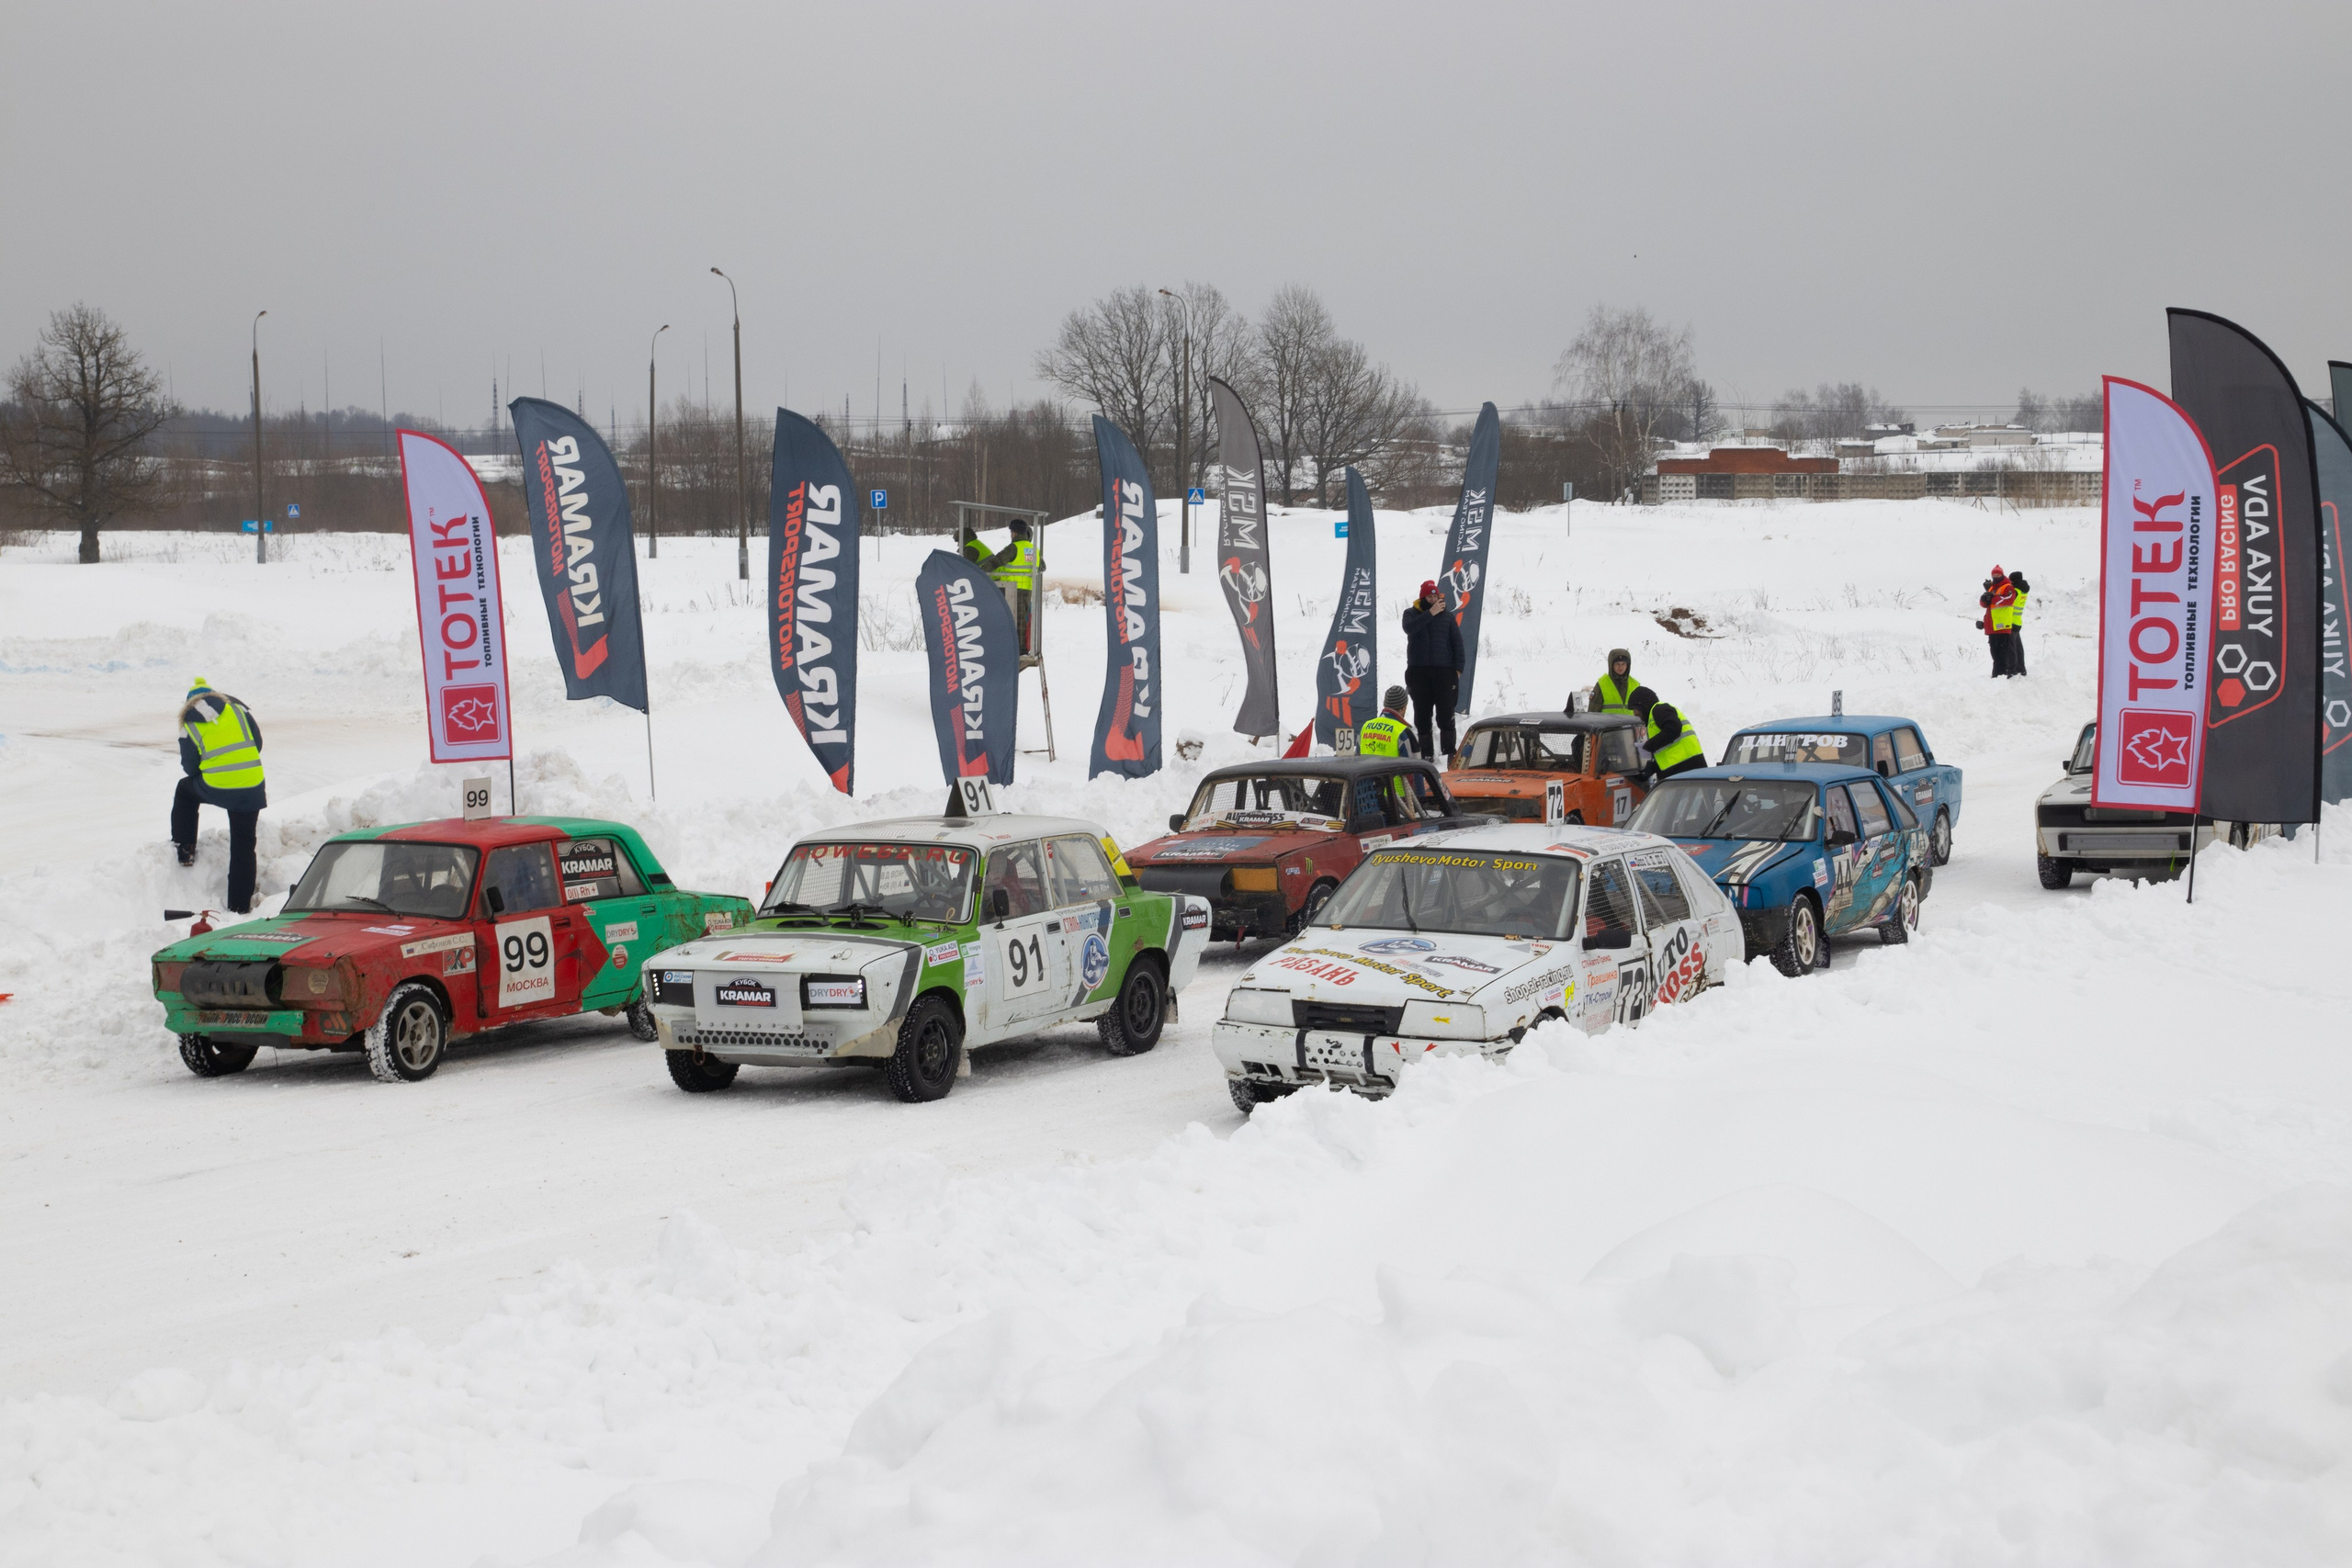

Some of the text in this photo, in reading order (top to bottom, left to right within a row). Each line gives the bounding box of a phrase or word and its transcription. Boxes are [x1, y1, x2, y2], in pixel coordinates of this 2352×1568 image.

[471, 516, 492, 667] ТОПЛИВНЫЕ ТЕХНОЛОГИИ
[2184, 495, 2201, 691] ТОПЛИВНЫЕ ТЕХНОЛОГИИ
[1365, 722, 1394, 732] RUSTA
[1339, 730, 1352, 750] 95
[1363, 732, 1391, 742] МАРШАЛ
[467, 788, 489, 807] 99
[965, 779, 993, 812] 91
[1548, 785, 1562, 819] 72
[1616, 796, 1627, 815] 17
[574, 843, 595, 853] КУБОК
[793, 845, 968, 864] ROWE62.RU
[561, 858, 613, 874] KRAMAR
[1371, 852, 1436, 866] Tyushevo
[1437, 856, 1487, 868] Motor
[1838, 859, 1852, 896] 44
[581, 886, 590, 896] Rh
[1183, 914, 1206, 926] KRAMAR
[422, 939, 452, 951] Сафонов
[503, 931, 548, 973] 99
[1009, 934, 1044, 987] 91
[1430, 956, 1496, 972] KRAMAR
[506, 976, 548, 993] МОСКВА
[735, 978, 757, 987] КУБОК
[1351, 957, 1406, 976] Motor
[1402, 972, 1455, 999] Sport
[1504, 964, 1574, 1004] shop.at-racing.ru
[1588, 970, 1617, 988] Тракшина
[719, 989, 771, 1002] KRAMAR
[810, 988, 847, 998] DRYDRY
[1619, 967, 1645, 1024] 72
